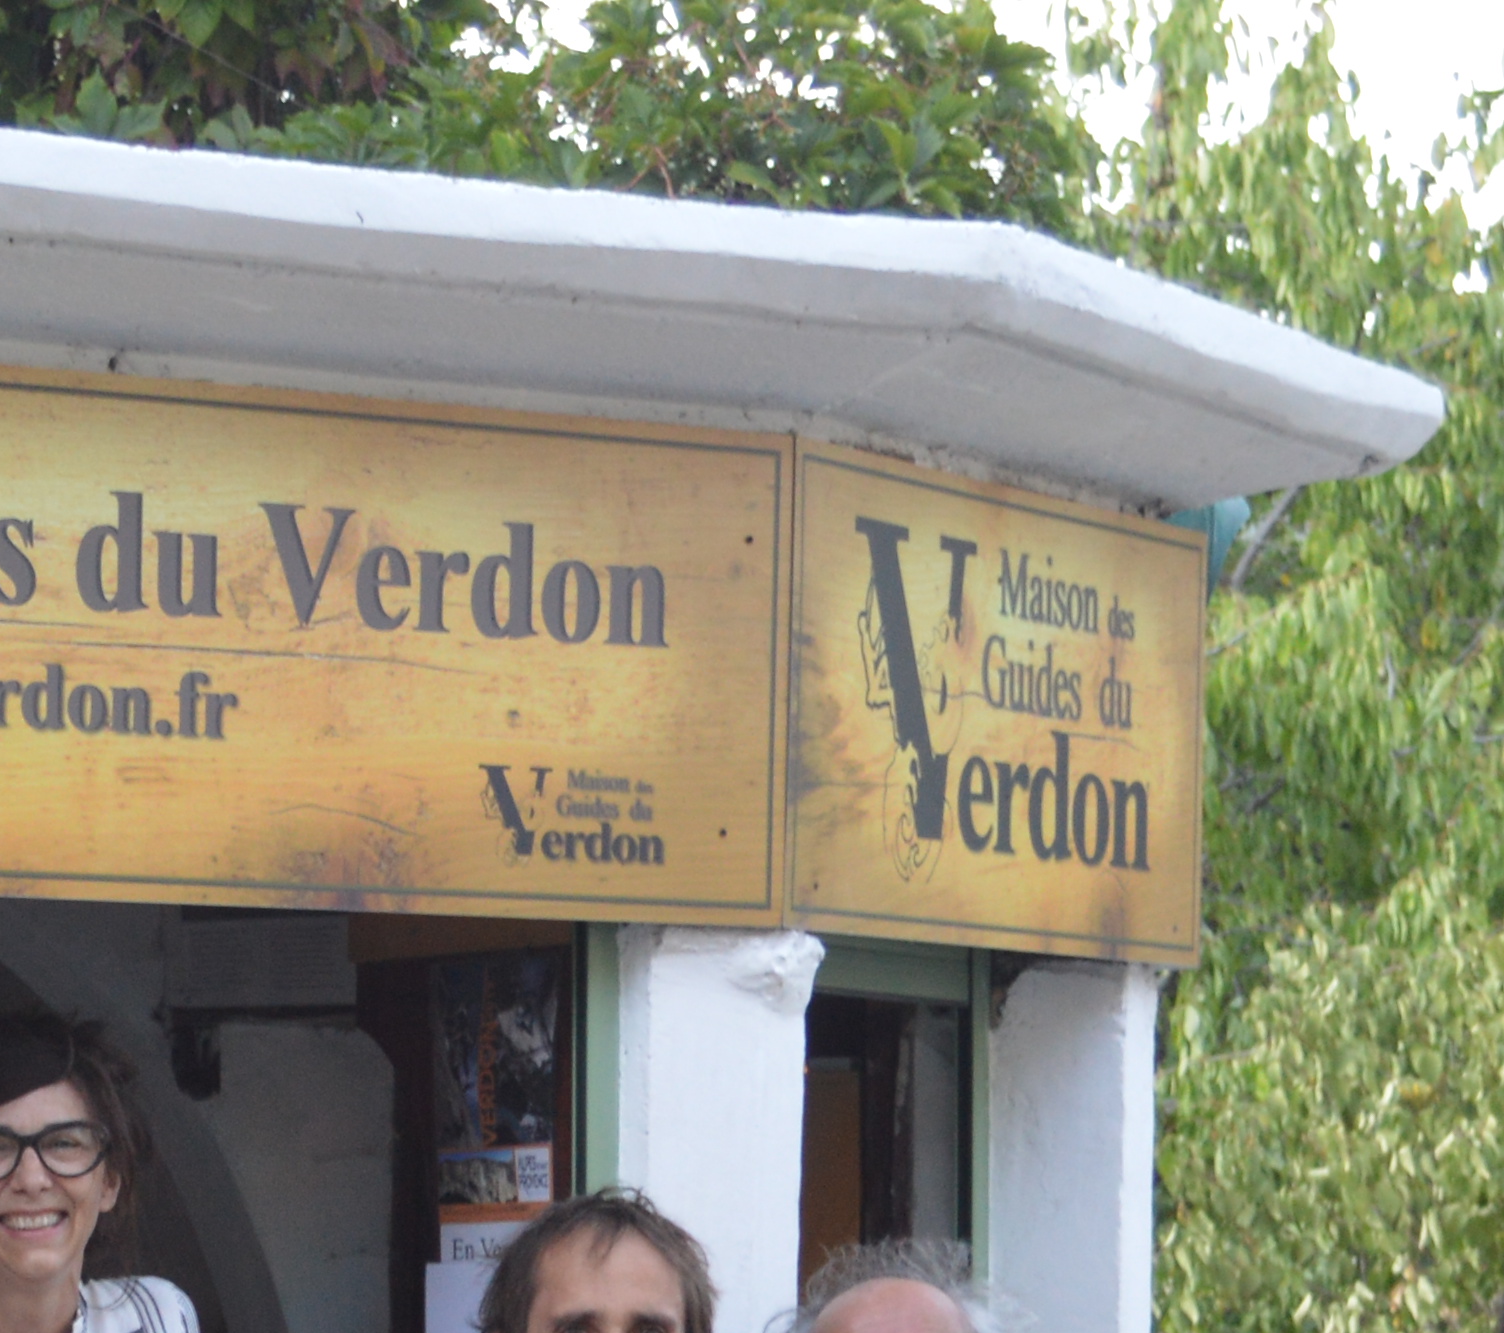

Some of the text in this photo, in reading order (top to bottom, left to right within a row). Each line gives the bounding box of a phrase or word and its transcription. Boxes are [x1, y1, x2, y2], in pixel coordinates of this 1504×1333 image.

[75, 492, 222, 619] du
[259, 502, 667, 649] Verdon
[998, 547, 1135, 640] Maison des
[855, 516, 1150, 872] Verdon
[981, 634, 1133, 729] Guides du
[479, 764, 665, 865] Verdon
[556, 793, 619, 819] Guides
[567, 769, 630, 793] Maison
[452, 1237, 475, 1261] En
